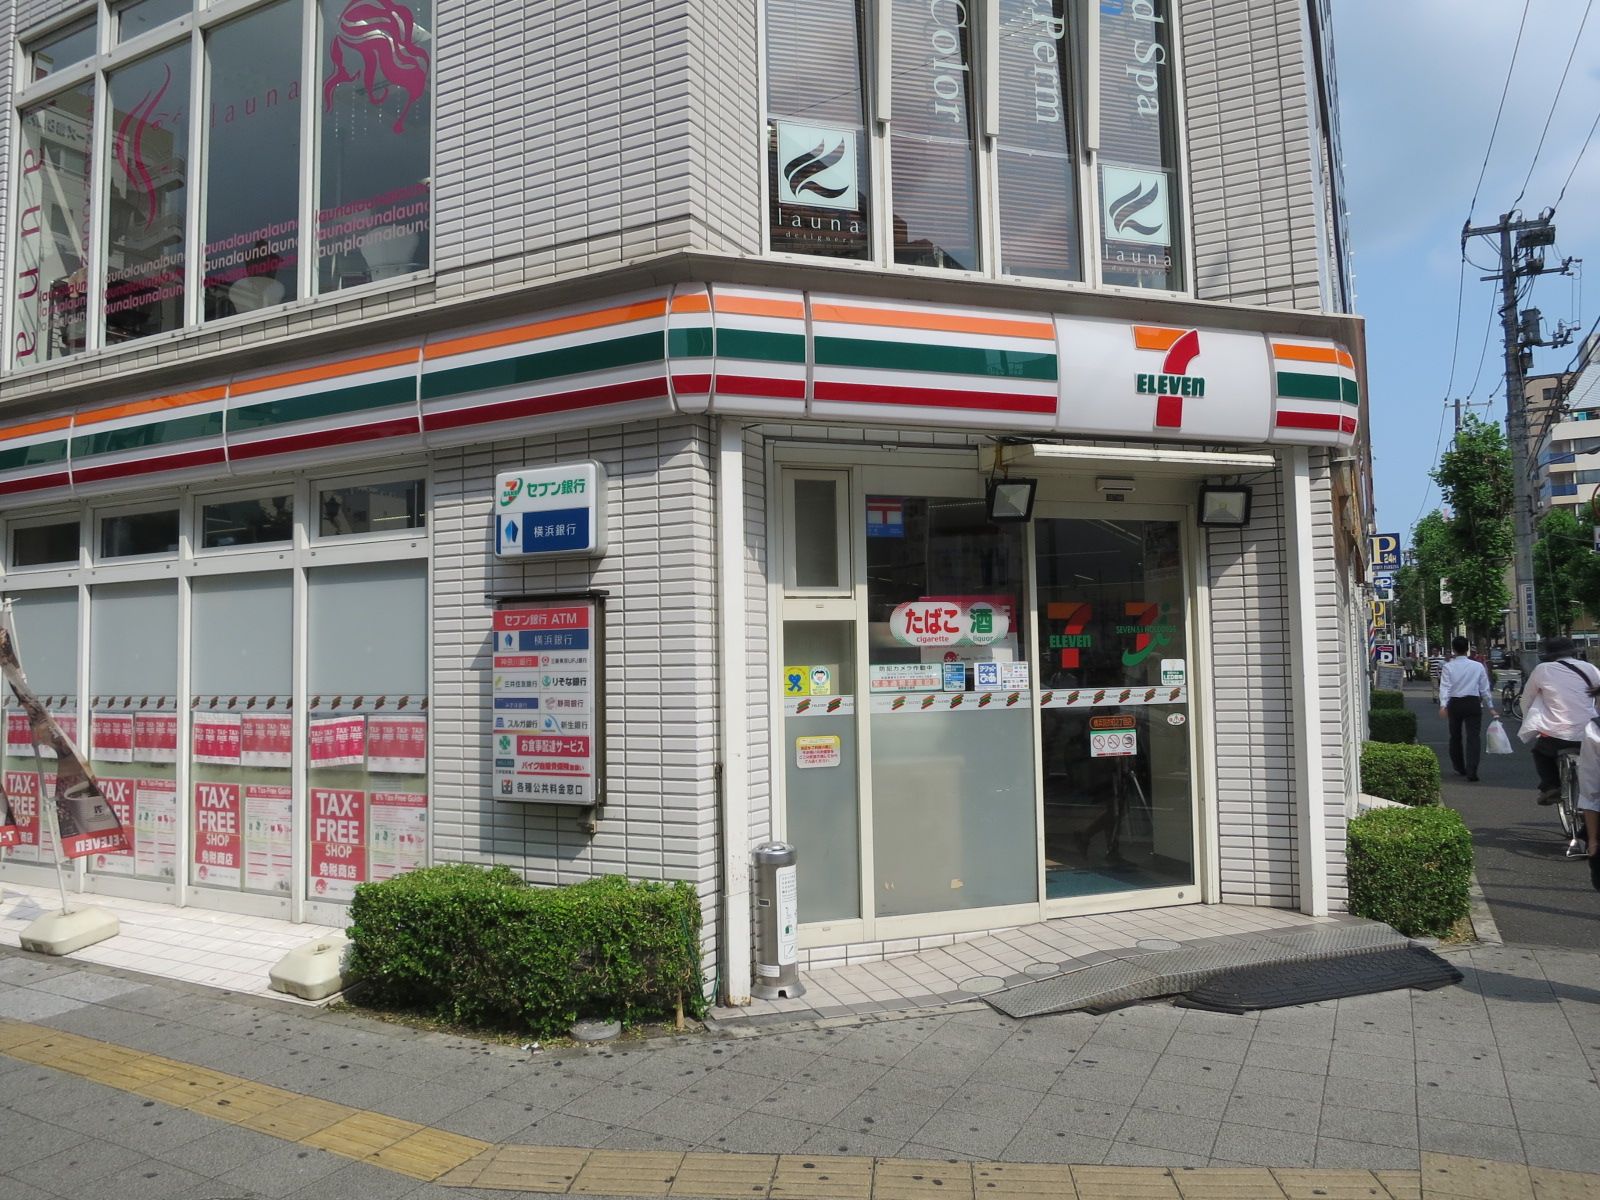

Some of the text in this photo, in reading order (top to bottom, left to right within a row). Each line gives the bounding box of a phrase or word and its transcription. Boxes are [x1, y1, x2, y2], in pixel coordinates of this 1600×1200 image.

[931, 0, 970, 123] Color
[1032, 8, 1065, 123] Perm
[1126, 39, 1167, 118] Spa
[778, 207, 860, 234] launa
[1105, 243, 1173, 267] launa
[526, 479, 586, 498] セブン銀行
[533, 523, 577, 539] 横浜銀行
[1371, 536, 1397, 565] P
[504, 612, 577, 627] セブン銀行 ATM
[905, 608, 960, 634] たばこ
[970, 608, 993, 633] 酒
[534, 634, 573, 646] 横浜銀行
[552, 676, 588, 687] りそな銀行
[507, 719, 538, 729] スルガ銀行
[521, 739, 585, 754] お食事配達サービス
[8, 774, 36, 795] TAX-
[98, 782, 131, 803] TAX-
[516, 781, 583, 796] 各種公共料金窓口
[199, 786, 236, 810] TAX-
[316, 792, 360, 817] TAX-
[199, 810, 236, 834] FREE
[316, 818, 360, 845] FREE
[206, 834, 230, 847] SHOP
[201, 850, 234, 866] 免税商店
[325, 844, 353, 859] SHOP
[320, 862, 357, 879] 免税商店
